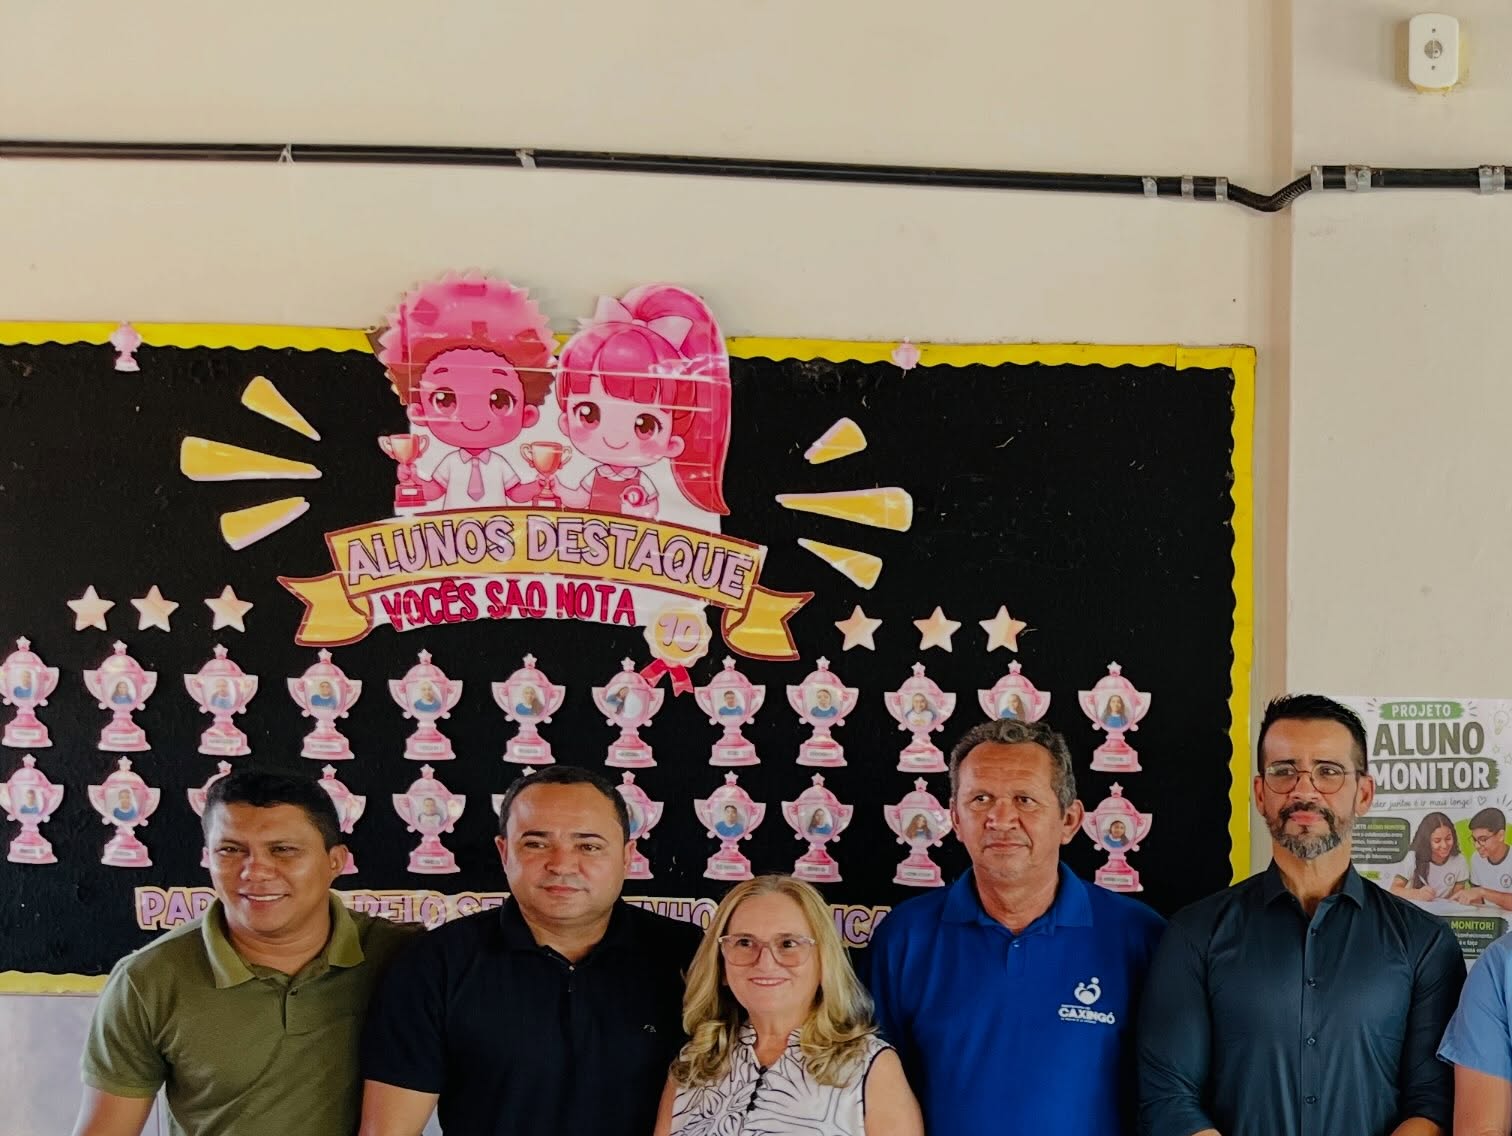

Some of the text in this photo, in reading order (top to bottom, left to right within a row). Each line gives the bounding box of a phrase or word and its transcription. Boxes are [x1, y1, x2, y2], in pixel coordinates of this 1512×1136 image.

[347, 515, 755, 599] ALUNOS DESTAQUE
[380, 578, 701, 653] VOCÊS SÃO NOTA 10
[1391, 703, 1452, 719] PROJETO
[1372, 721, 1485, 757] ALUNO
[1369, 761, 1490, 791] MONITOR
[1451, 920, 1495, 930] MONITOR!
[1058, 1007, 1116, 1025] CAXINGÓ
